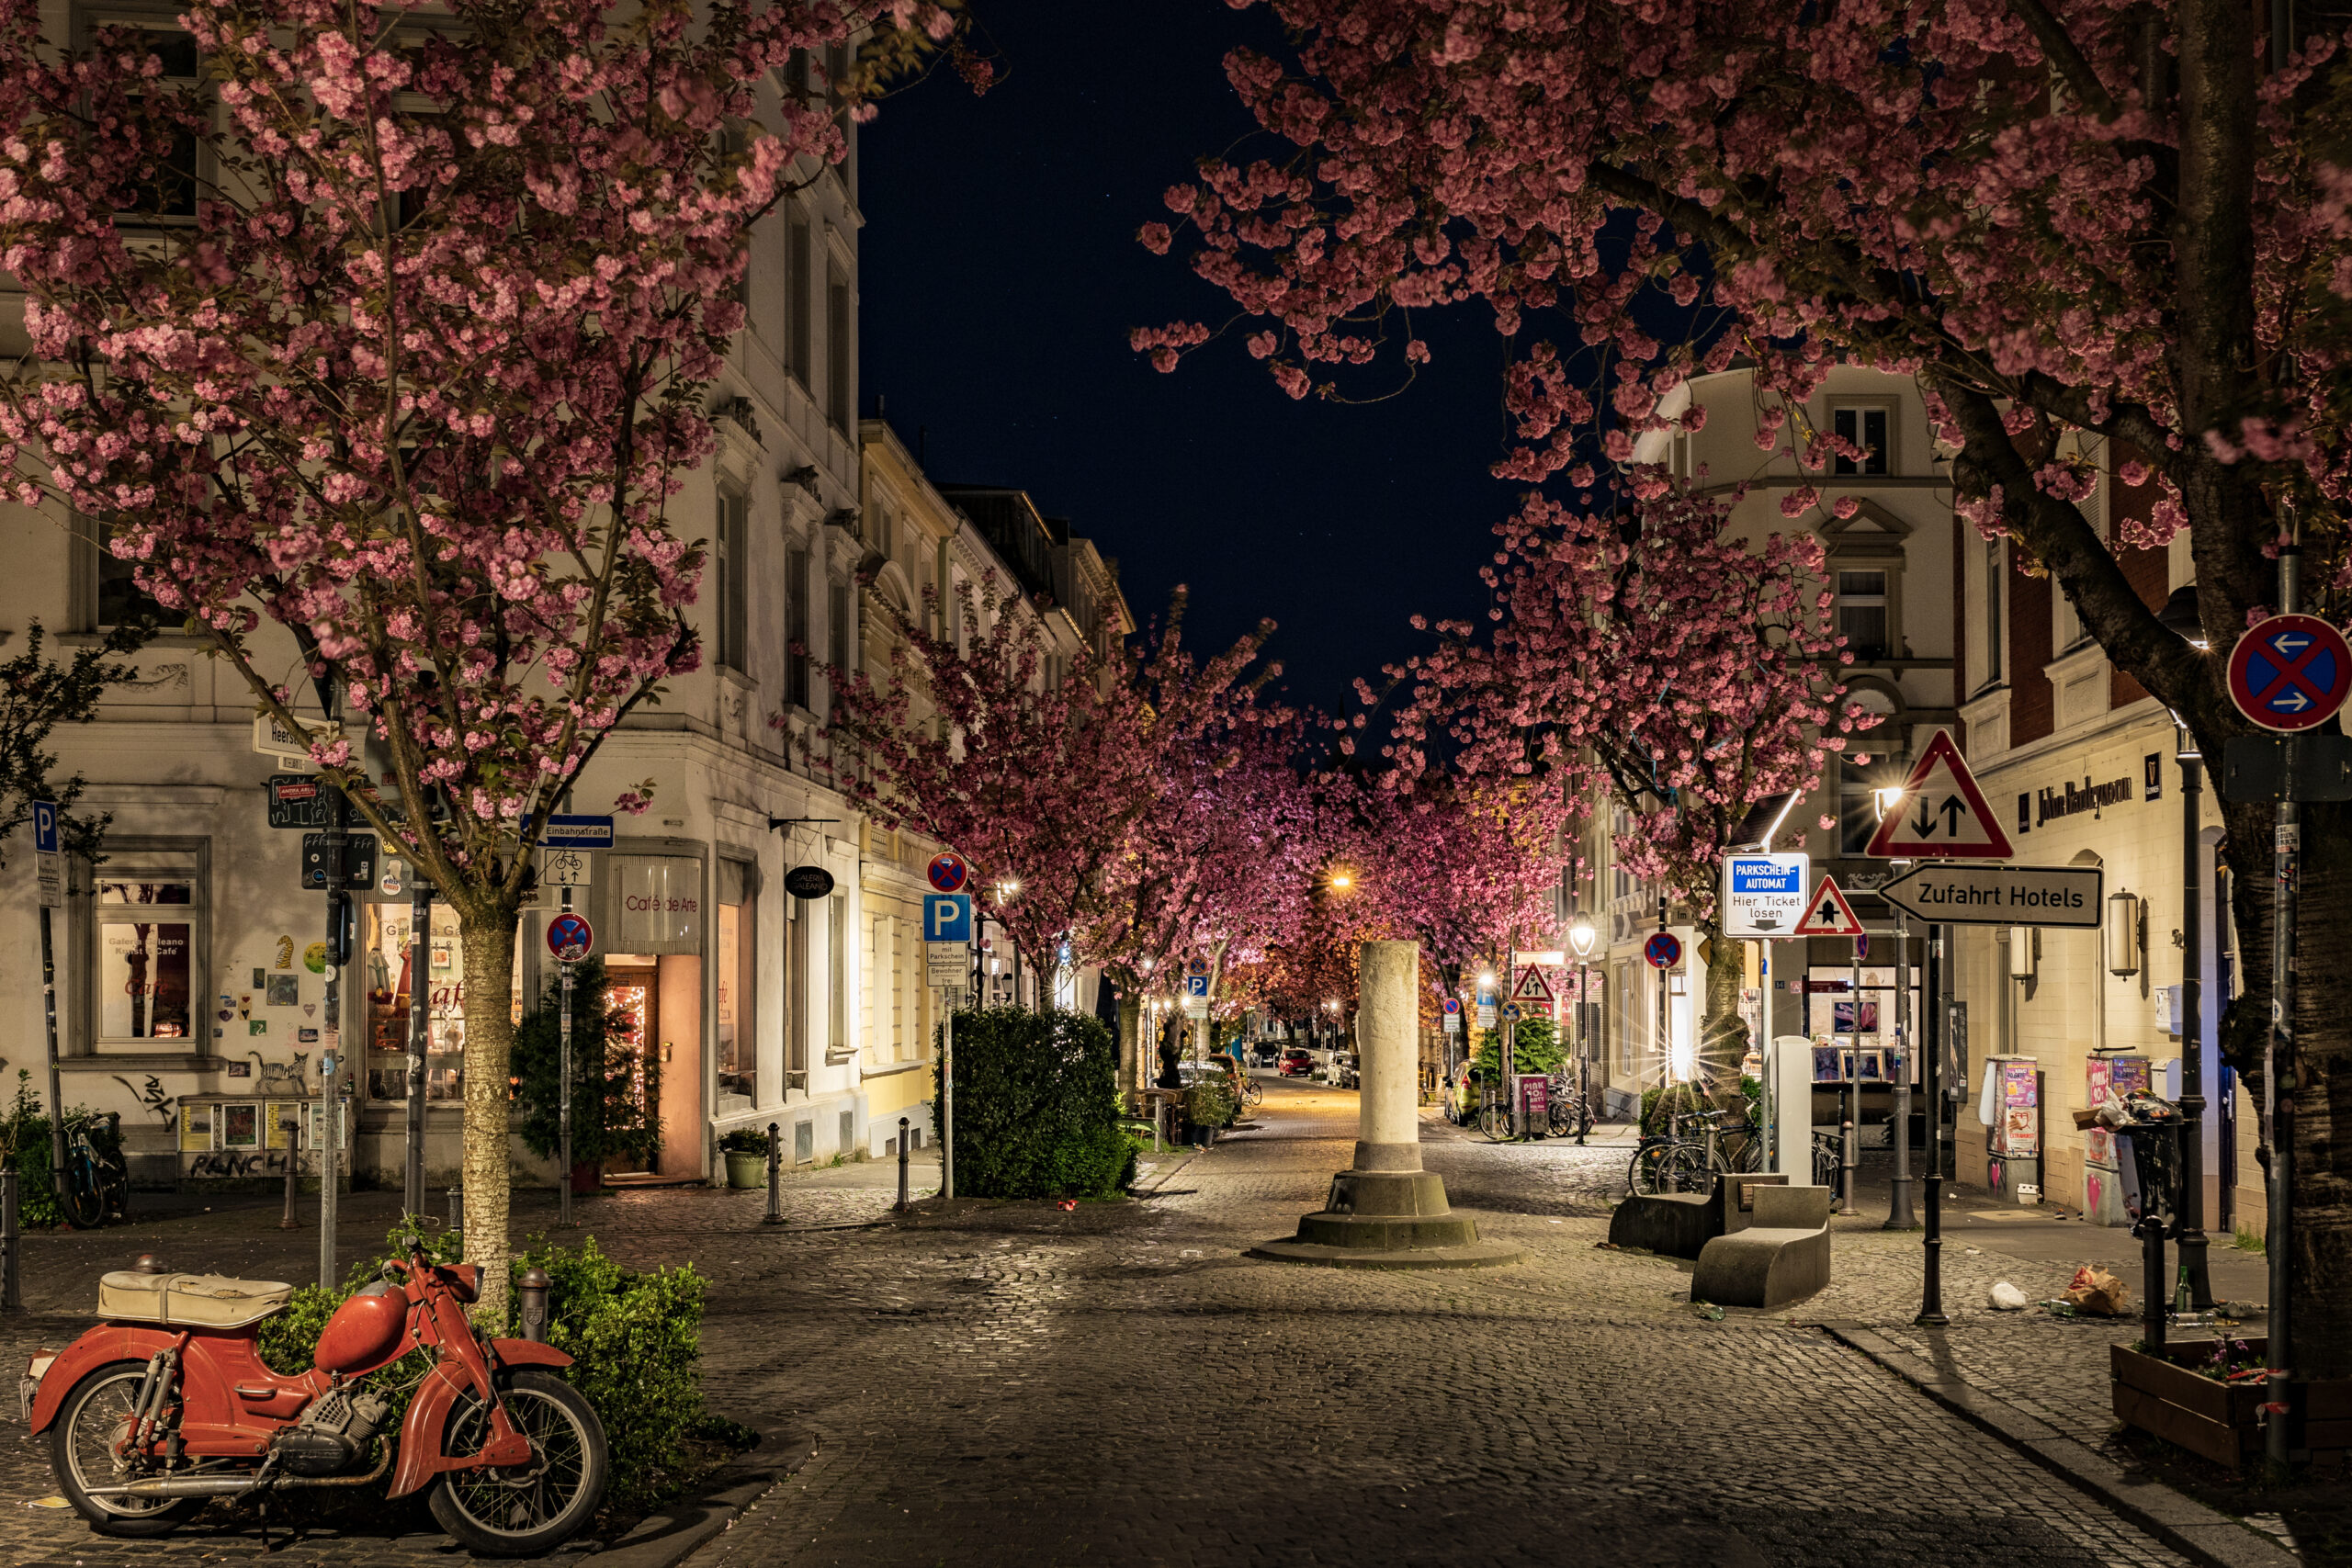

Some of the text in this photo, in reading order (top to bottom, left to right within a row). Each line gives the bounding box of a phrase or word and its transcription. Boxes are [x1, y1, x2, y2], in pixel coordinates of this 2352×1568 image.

[40, 808, 51, 844] P
[546, 827, 608, 836] Einbahnstraße
[1736, 865, 1796, 875] PARKSCHEIN-
[1746, 878, 1787, 888] AUTOMAT
[1733, 896, 1800, 906] Hier Ticket
[1918, 884, 2084, 908] Zufahrt Hotels
[626, 895, 697, 913] Café de Arte
[934, 900, 960, 935] P
[1749, 908, 1782, 918] lösen
[386, 925, 439, 936] Gala
[108, 937, 184, 945] Galeria Galeano
[115, 947, 143, 955] Kunst
[1192, 978, 1204, 994] P
[1523, 1081, 1544, 1091] PINK
